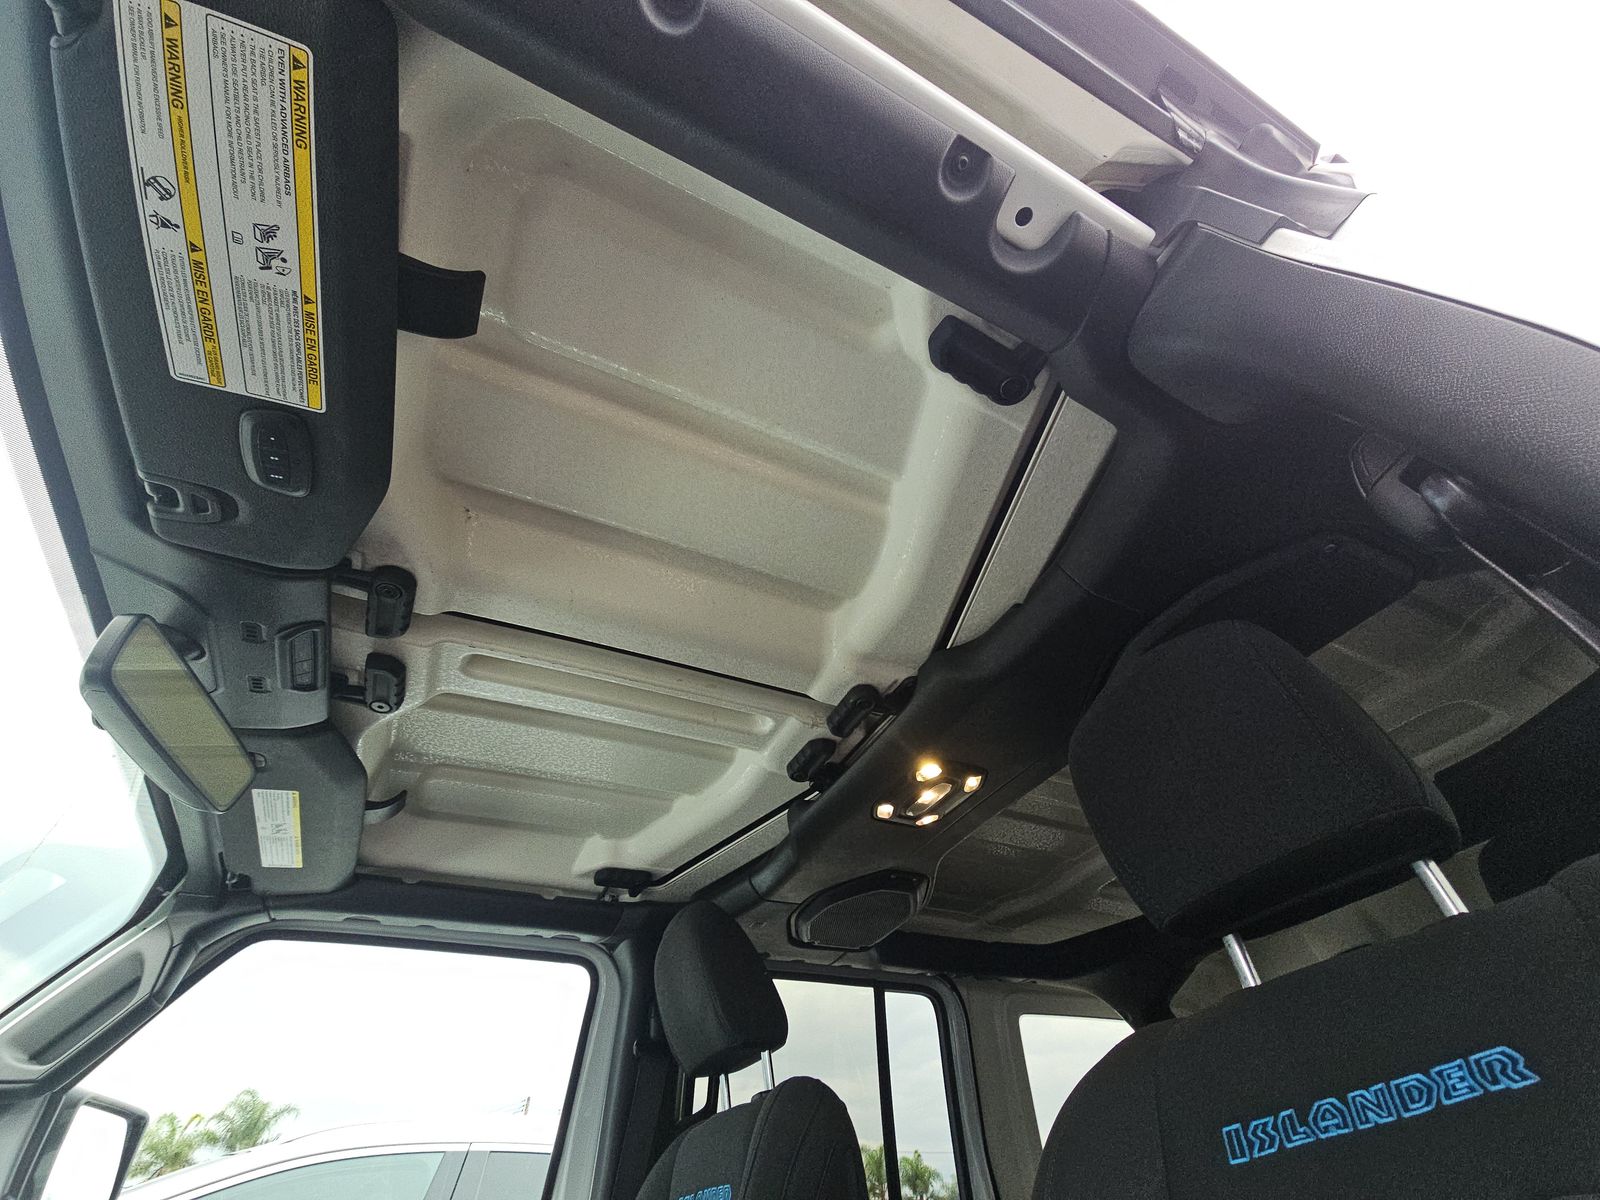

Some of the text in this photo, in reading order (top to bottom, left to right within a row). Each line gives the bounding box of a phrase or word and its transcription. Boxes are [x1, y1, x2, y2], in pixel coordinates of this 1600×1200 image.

[218, 30, 226, 46] SEE
[228, 34, 237, 63] ALWAYS
[238, 38, 246, 64] NEVER
[164, 35, 184, 111] WARNING
[230, 62, 238, 78] USE
[241, 76, 248, 84] A
[249, 57, 257, 78] BACK
[222, 78, 231, 106] MANUAL
[231, 77, 241, 114] SEATBELTS
[252, 94, 258, 103] IS
[266, 48, 275, 85] CHILDREN
[271, 130, 278, 142] OR
[234, 113, 242, 128] AND
[243, 101, 251, 127] FACING
[277, 47, 291, 196] EVEN WITH ADVANCED AIRBAGS
[292, 77, 307, 150] WARNING
[226, 119, 234, 140] MORE
[235, 127, 243, 147] CHILD
[253, 115, 261, 140] SAFEST
[227, 139, 237, 180] INFORMATION
[247, 160, 254, 169] IN
[231, 179, 239, 200] ABOUT
[257, 173, 265, 203] CHILDREN
[191, 258, 215, 344] MISE EN GARDE
[304, 310, 318, 386] MISE EN GARDE
[1222, 1045, 1541, 1165] ISLANDER
